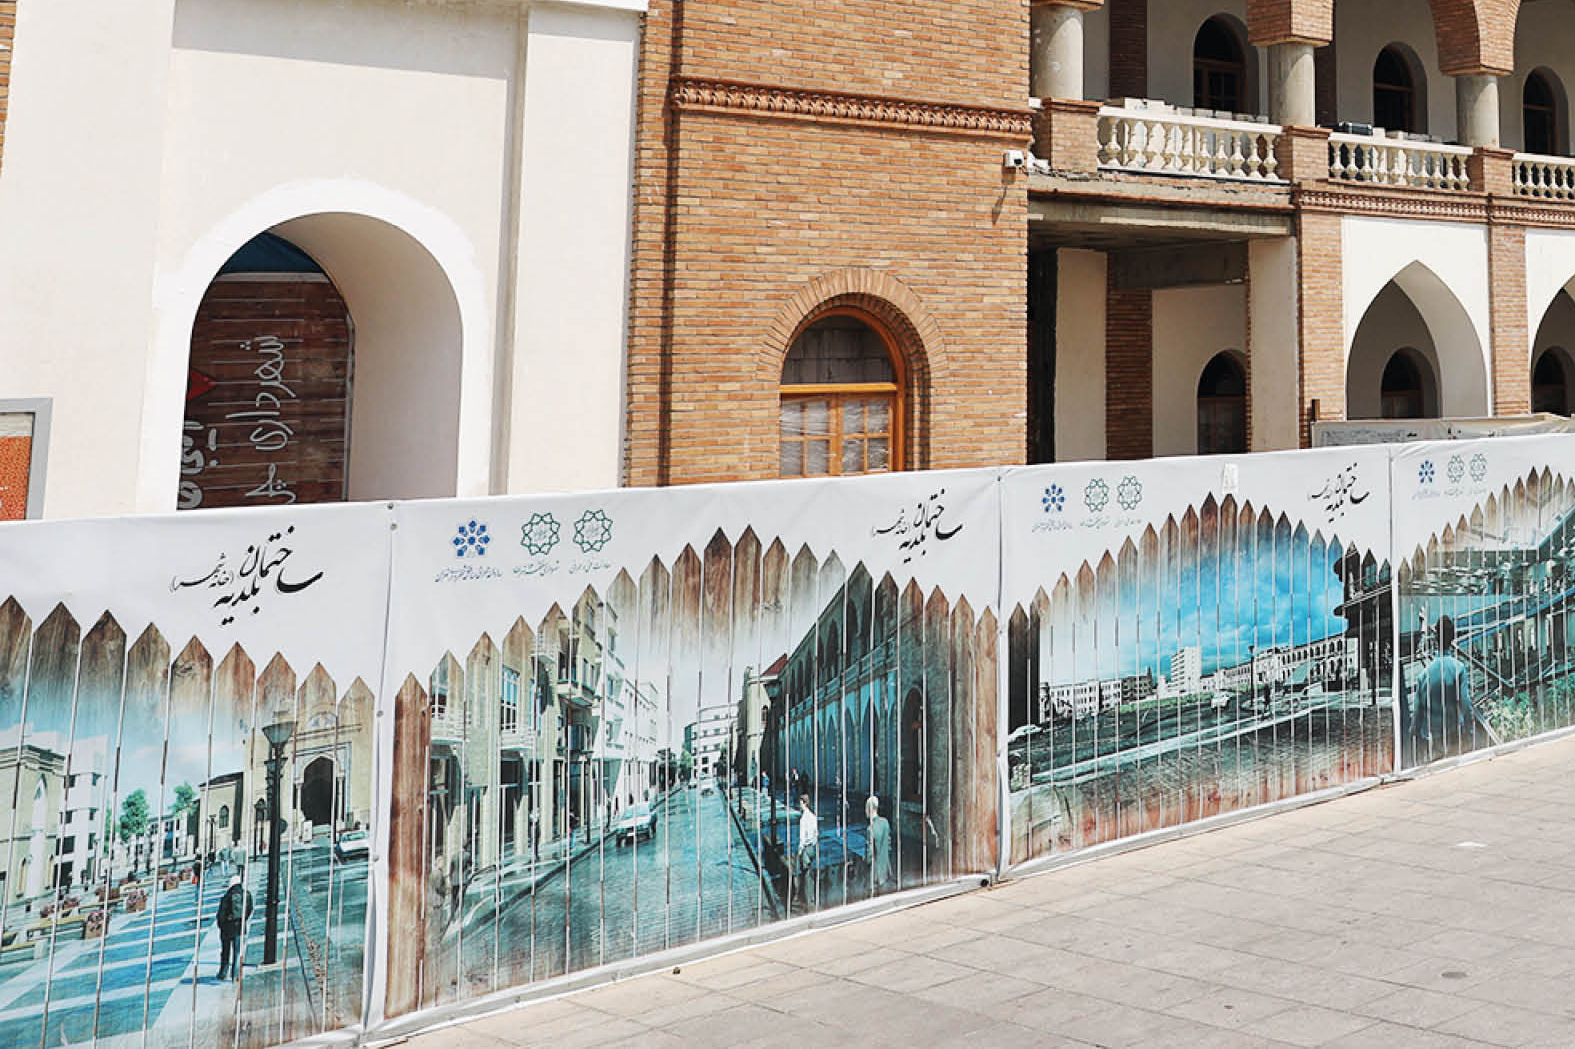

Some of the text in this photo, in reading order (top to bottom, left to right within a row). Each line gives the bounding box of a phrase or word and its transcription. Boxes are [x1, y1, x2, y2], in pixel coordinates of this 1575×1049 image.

[225, 334, 297, 450] شهرداری
[239, 525, 325, 594] ساختمان
[213, 575, 260, 626] بلدیه
